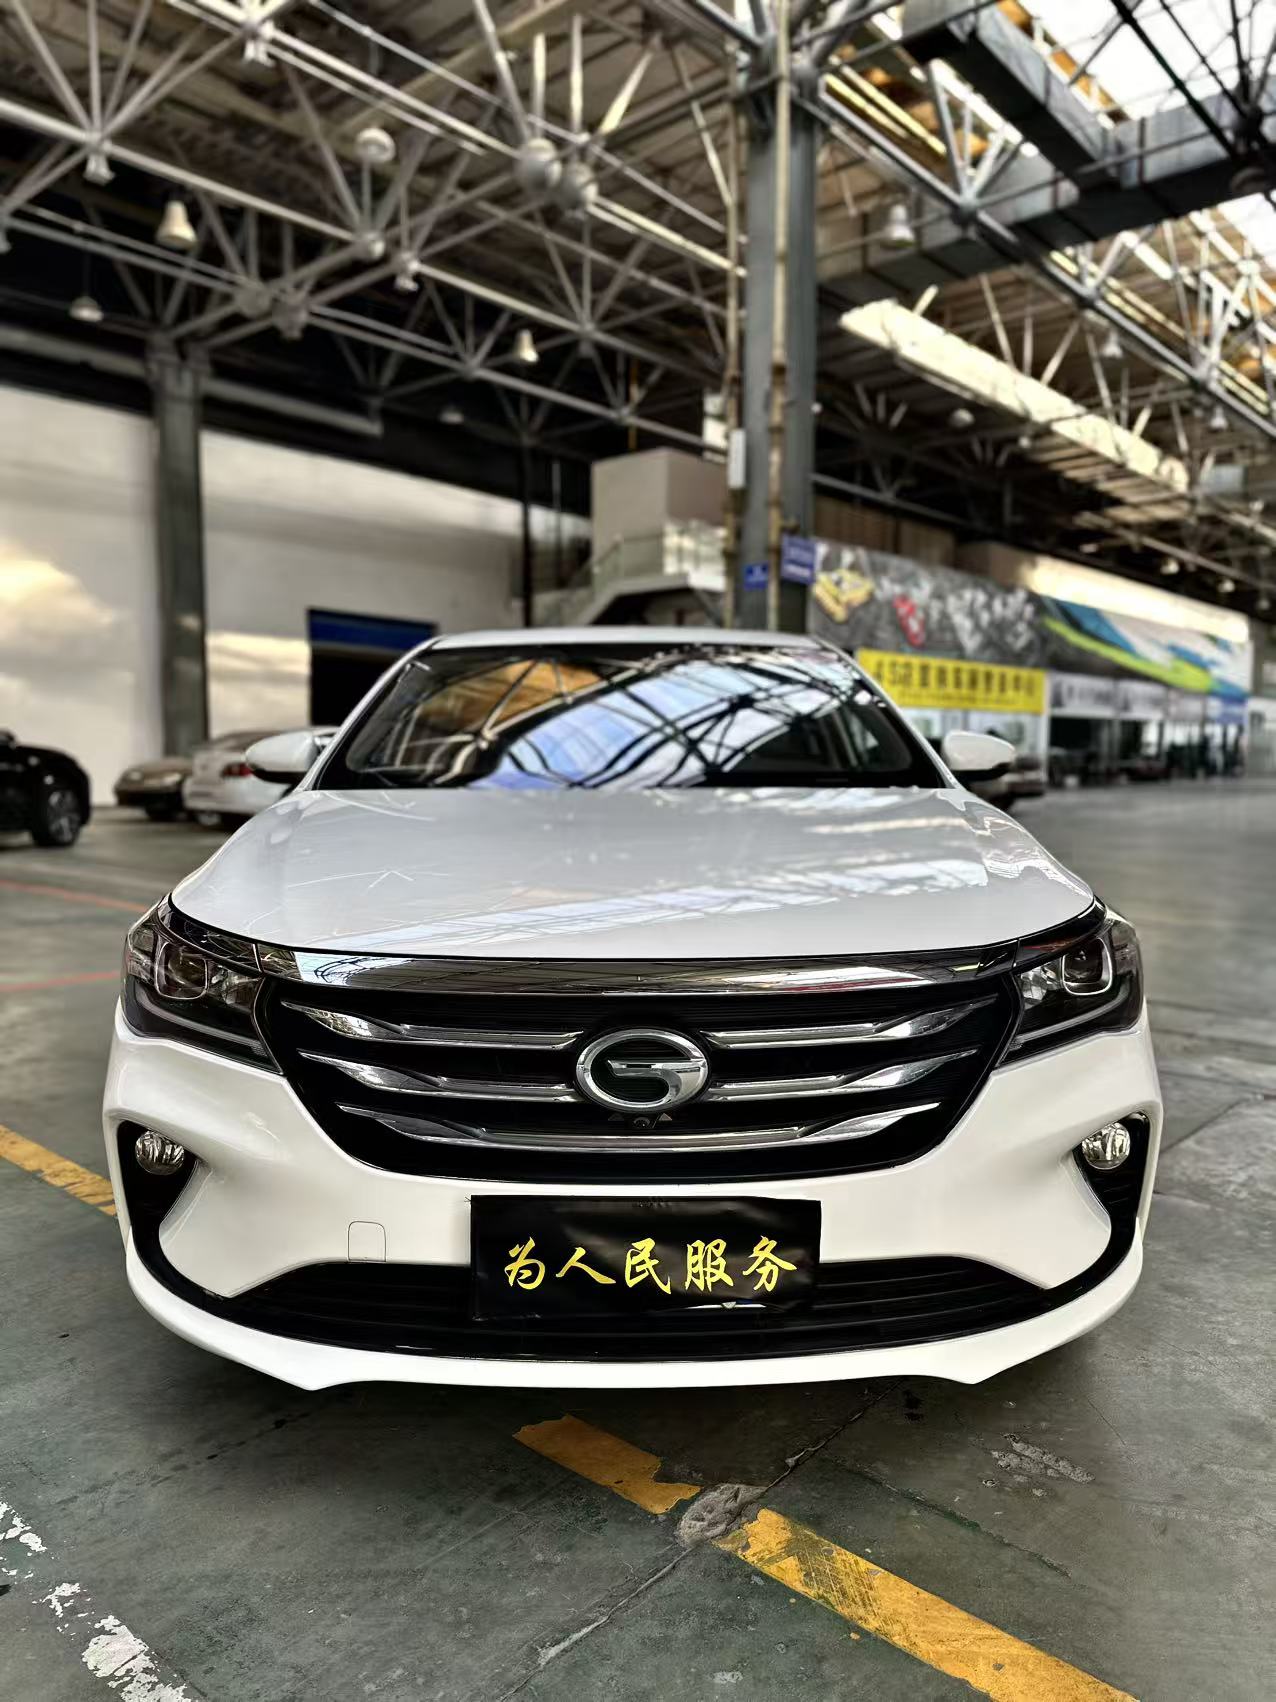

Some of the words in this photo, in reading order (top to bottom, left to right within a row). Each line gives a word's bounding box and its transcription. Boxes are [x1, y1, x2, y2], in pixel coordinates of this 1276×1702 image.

[504, 1236, 797, 1295] 为人民服务
